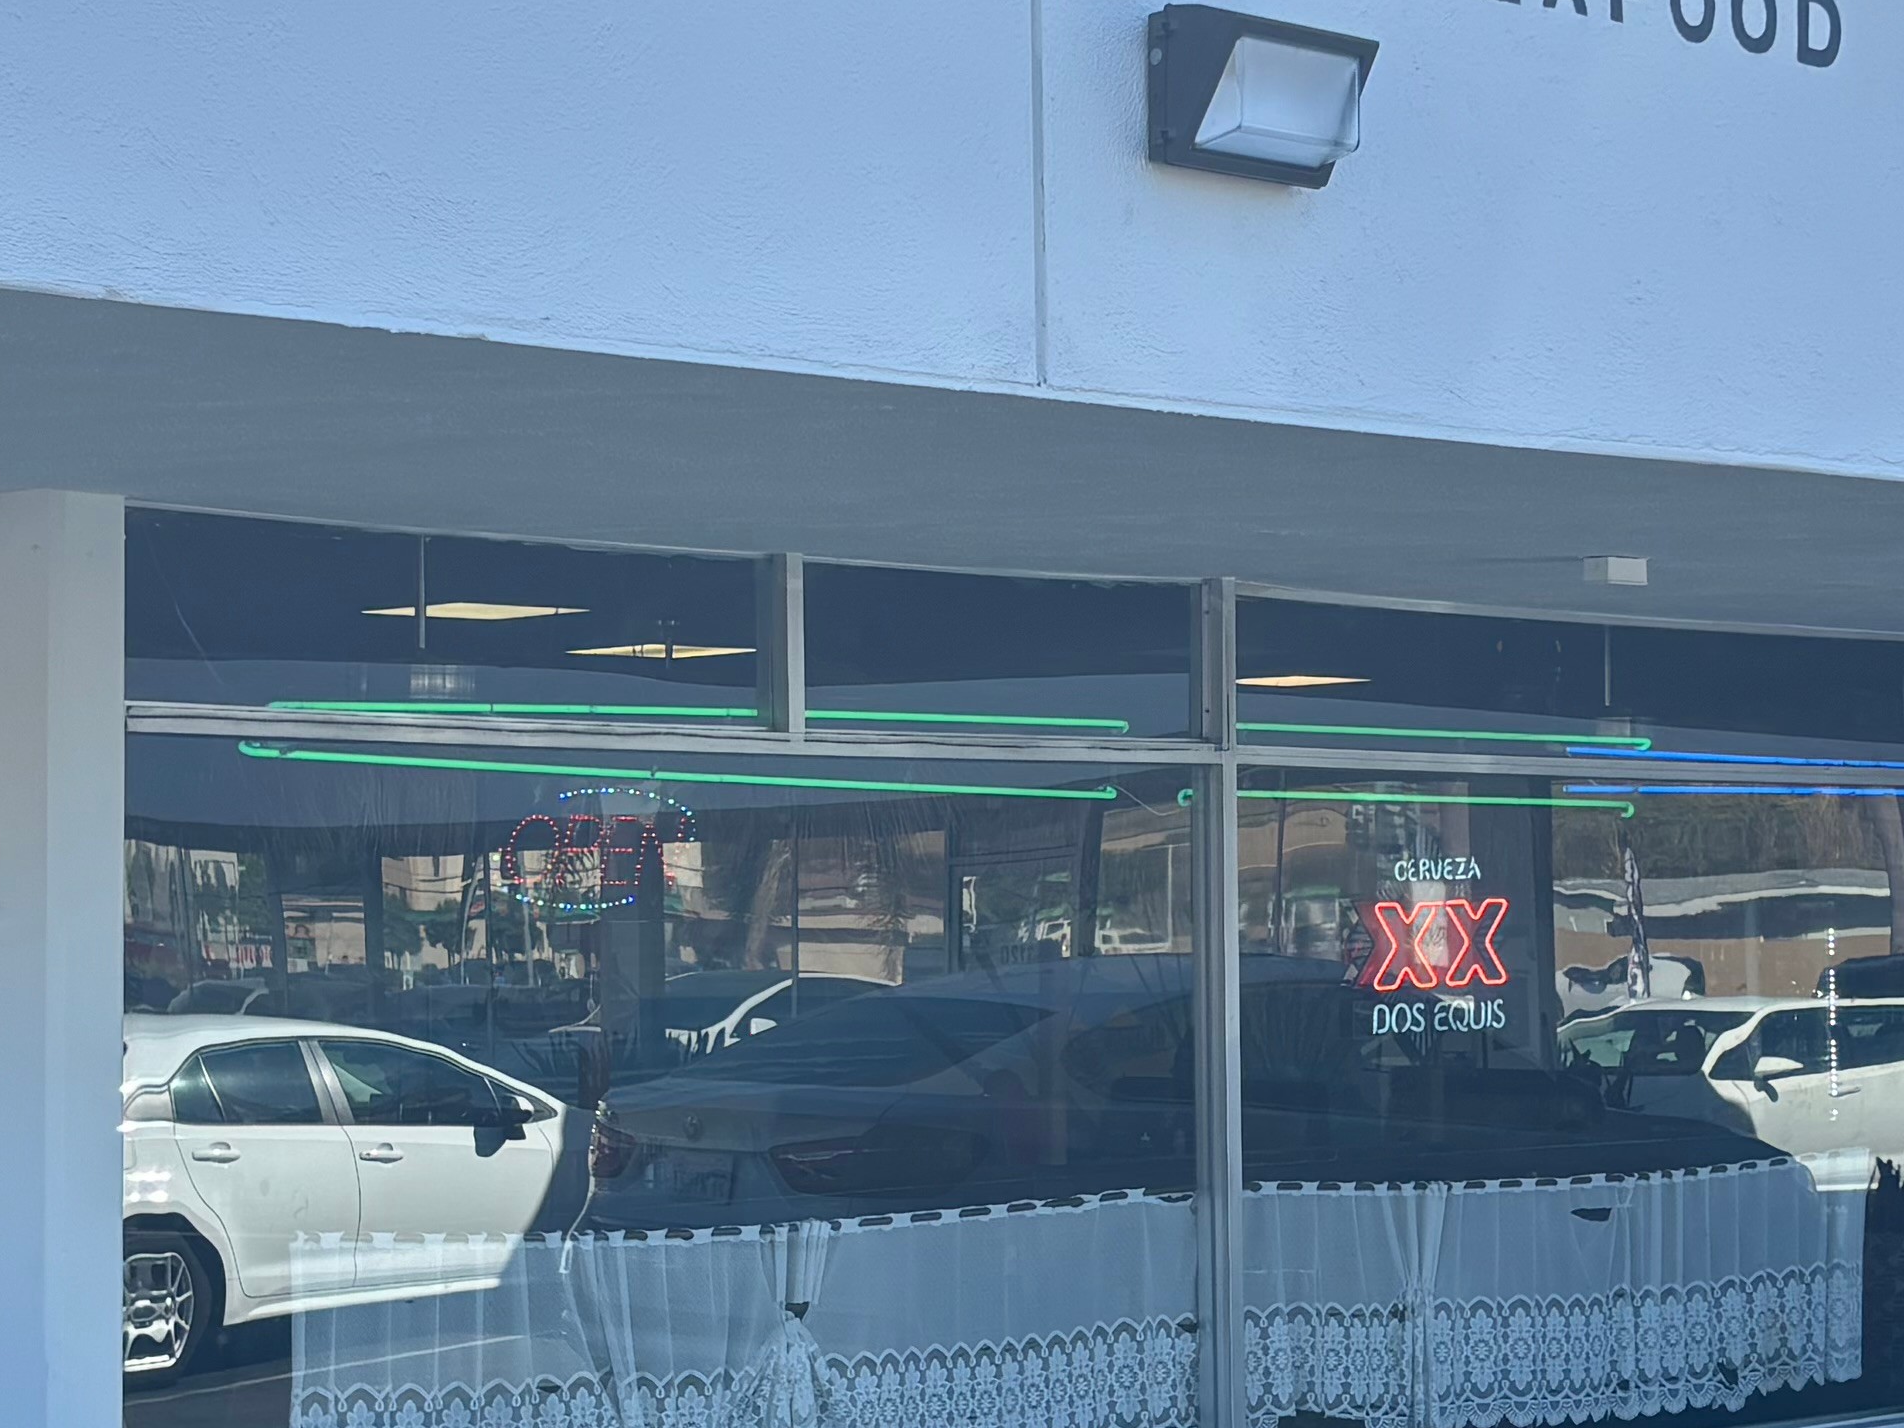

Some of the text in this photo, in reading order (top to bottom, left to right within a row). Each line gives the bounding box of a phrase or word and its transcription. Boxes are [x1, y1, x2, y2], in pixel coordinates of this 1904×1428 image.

[506, 814, 687, 888] OPEN
[1394, 856, 1482, 882] CERVEZA
[1373, 897, 1509, 992] XX
[1372, 998, 1507, 1035] DOS EQUIS
